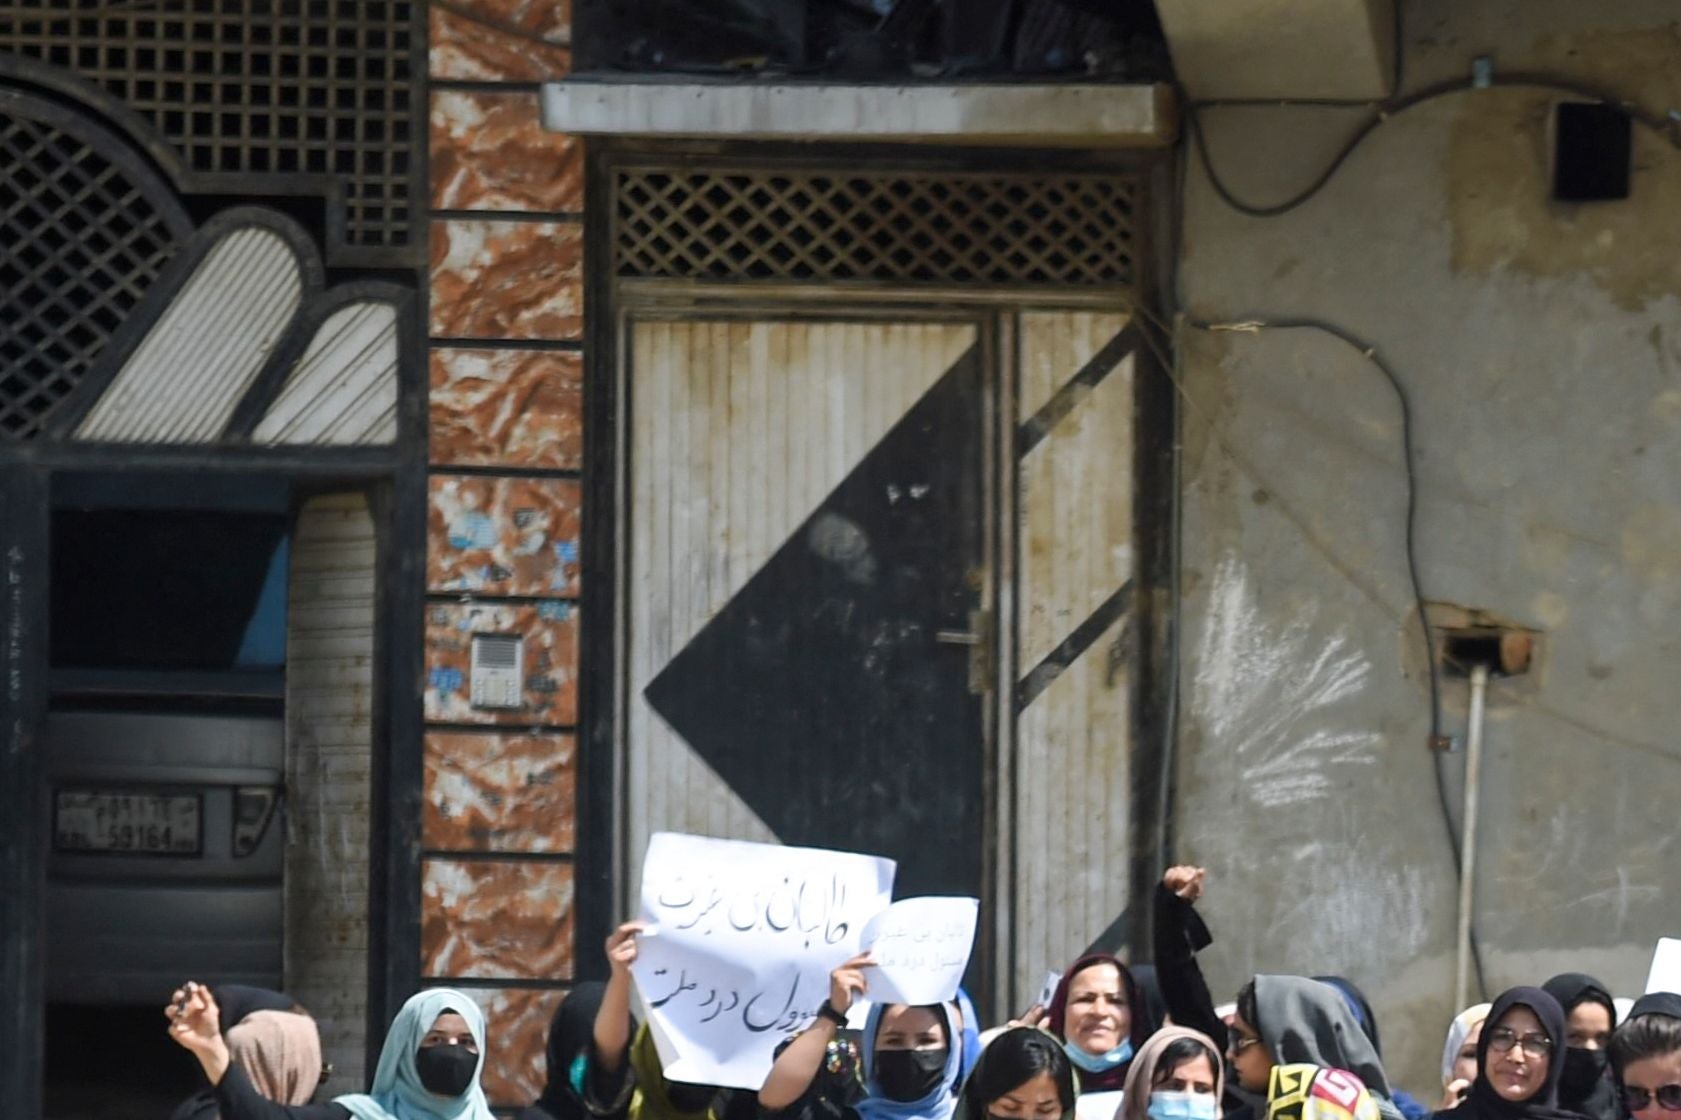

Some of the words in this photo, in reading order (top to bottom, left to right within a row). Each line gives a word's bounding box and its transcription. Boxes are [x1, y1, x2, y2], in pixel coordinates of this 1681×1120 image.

[766, 872, 849, 949] طالبان
[649, 969, 698, 1008] ملت
[697, 989, 739, 1023] درد
